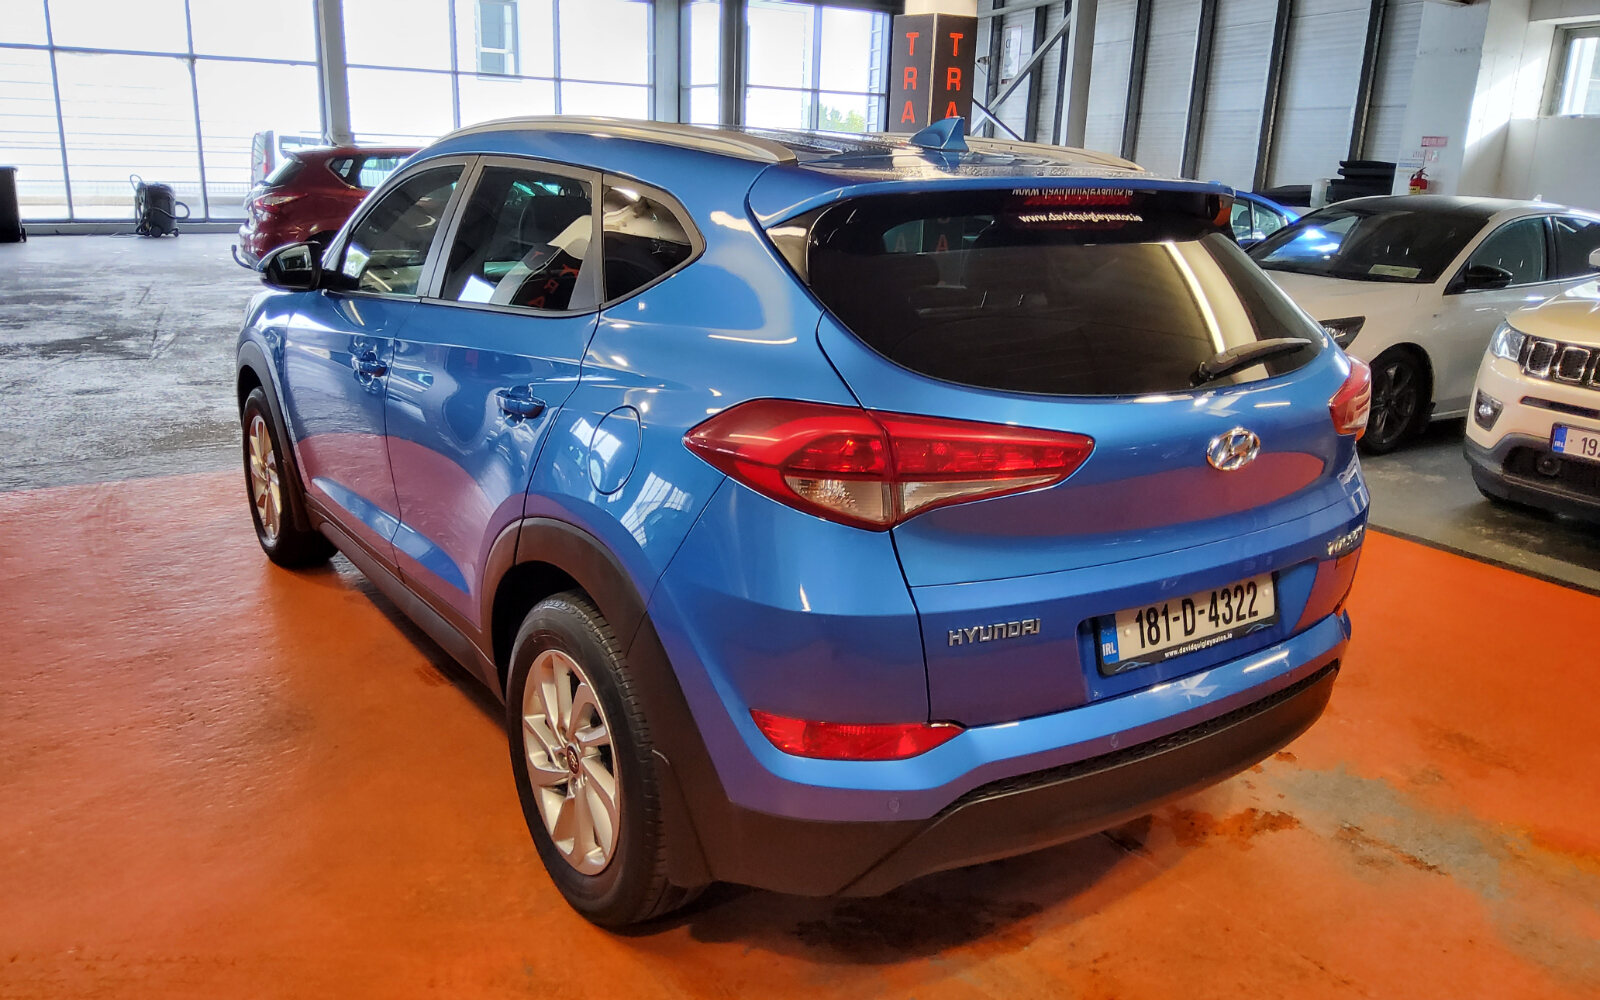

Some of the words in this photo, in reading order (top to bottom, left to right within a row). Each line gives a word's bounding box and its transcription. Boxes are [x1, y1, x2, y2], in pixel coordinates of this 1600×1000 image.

[1582, 436, 1600, 458] 19
[1135, 581, 1259, 649] 181-D-4322
[948, 618, 1040, 646] HYUNDAI
[1164, 632, 1233, 658] www.davidquigleyautos.ie
[1102, 641, 1117, 657] IRL
